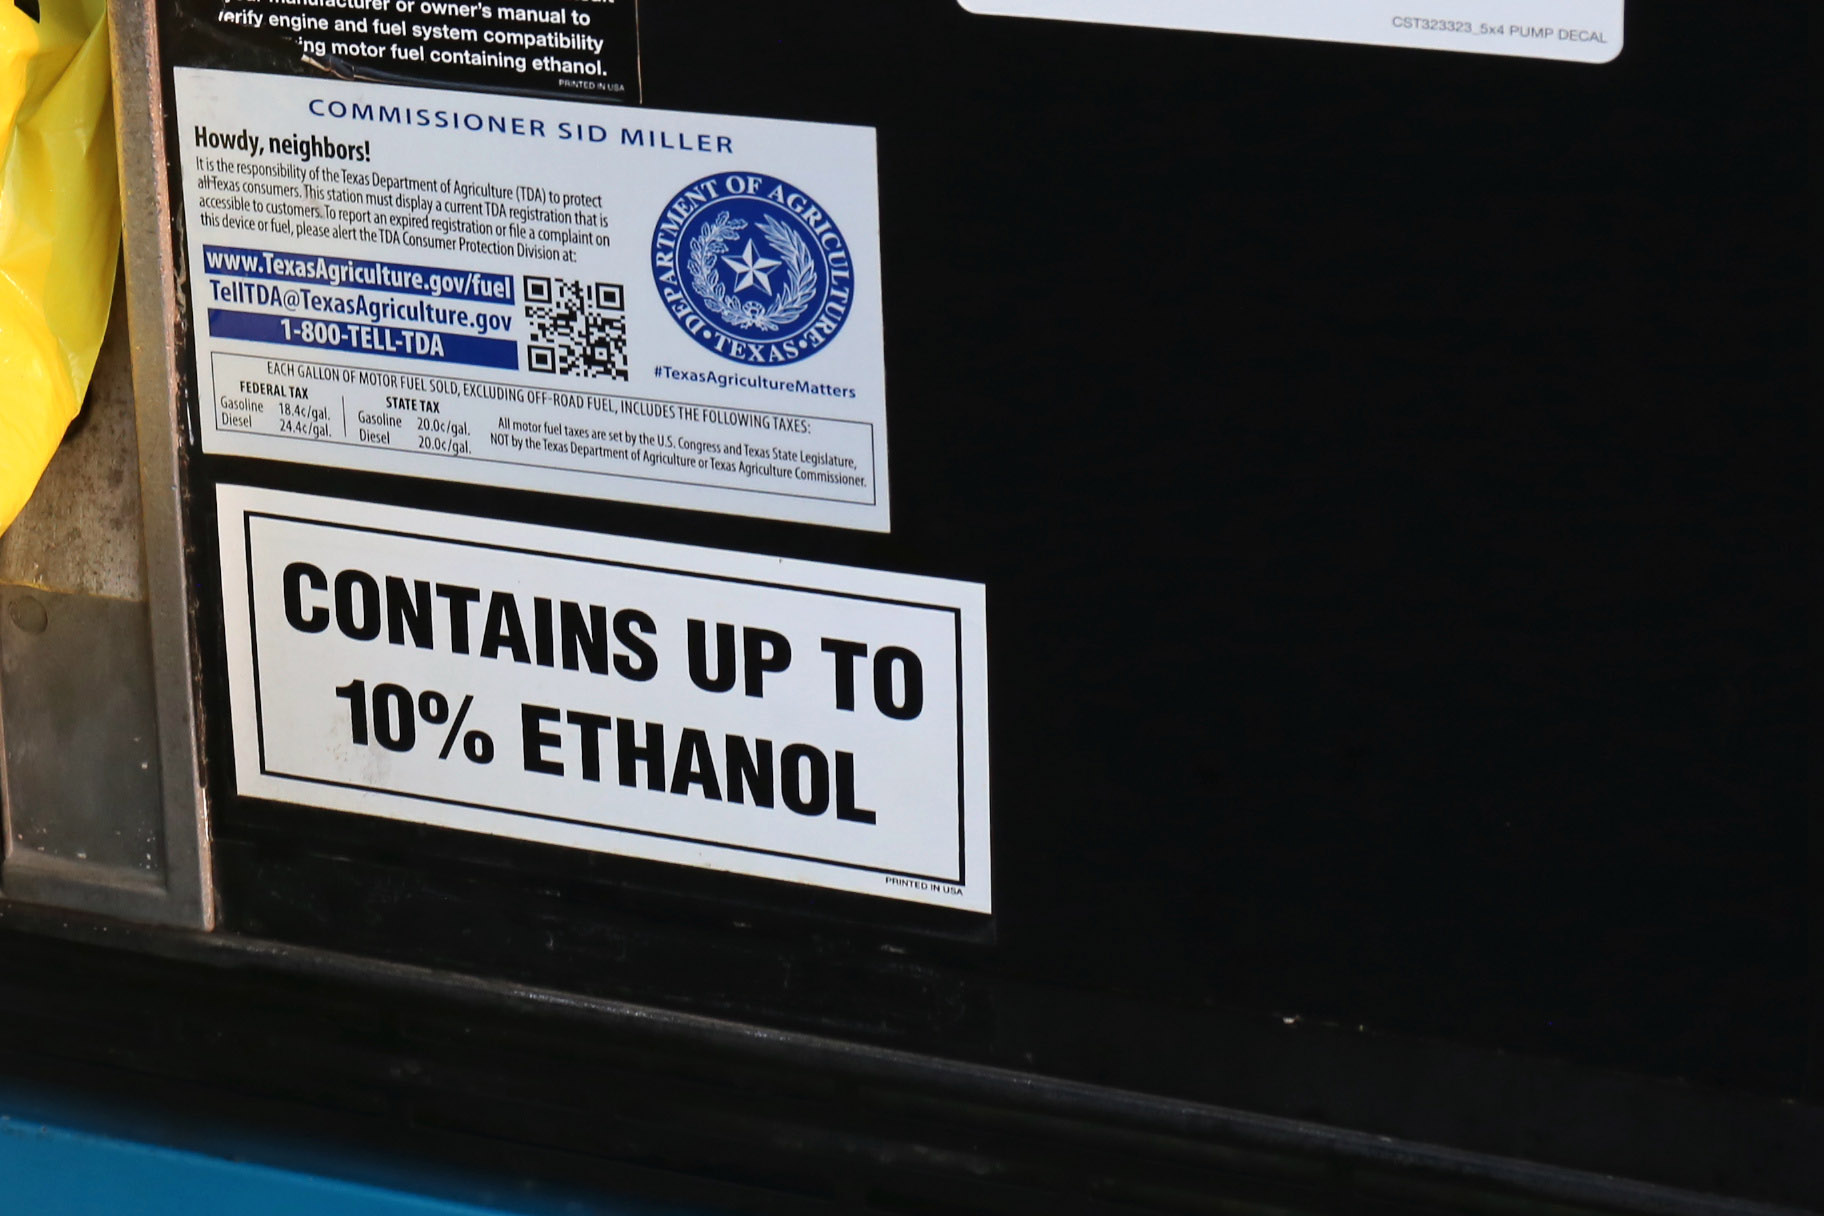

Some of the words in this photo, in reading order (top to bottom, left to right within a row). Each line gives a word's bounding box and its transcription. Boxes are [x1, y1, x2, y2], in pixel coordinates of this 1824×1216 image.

[1510, 24, 1555, 39] PUMP
[1557, 27, 1608, 44] DECAL
[308, 98, 545, 137] COMMISSIONER
[558, 122, 607, 143] SID
[621, 127, 733, 154] MILLER
[194, 125, 265, 158] Howdy,
[268, 133, 371, 163] neighbors!
[204, 251, 511, 299] www.TexasAgriculture.gov/fuel
[654, 177, 719, 335] DEPARTMENT
[724, 173, 763, 195] OF
[767, 178, 851, 349] AGRICULTURE
[209, 279, 512, 333] TellTDA@TexasAgriculture.gov
[277, 318, 447, 357] 1-800-TELL-TDA
[714, 335, 801, 364] TEXAS
[239, 381, 286, 397] FEDERAL
[289, 386, 309, 400] TAX
[654, 365, 856, 399] #TexasAgricultureMatters
[220, 395, 264, 413] Gasoline
[221, 411, 252, 428] Diesel
[357, 410, 402, 428] Gasoline
[386, 396, 417, 411] STATE
[419, 400, 440, 414] TAX
[359, 427, 390, 445] Diesel
[281, 562, 661, 684] CONTAINS
[684, 616, 794, 701] UP
[818, 635, 929, 721] TO
[335, 679, 495, 764] 10%
[521, 703, 877, 825] ETHANOL
[885, 876, 928, 890] PRINTED
[942, 884, 965, 896] USA
